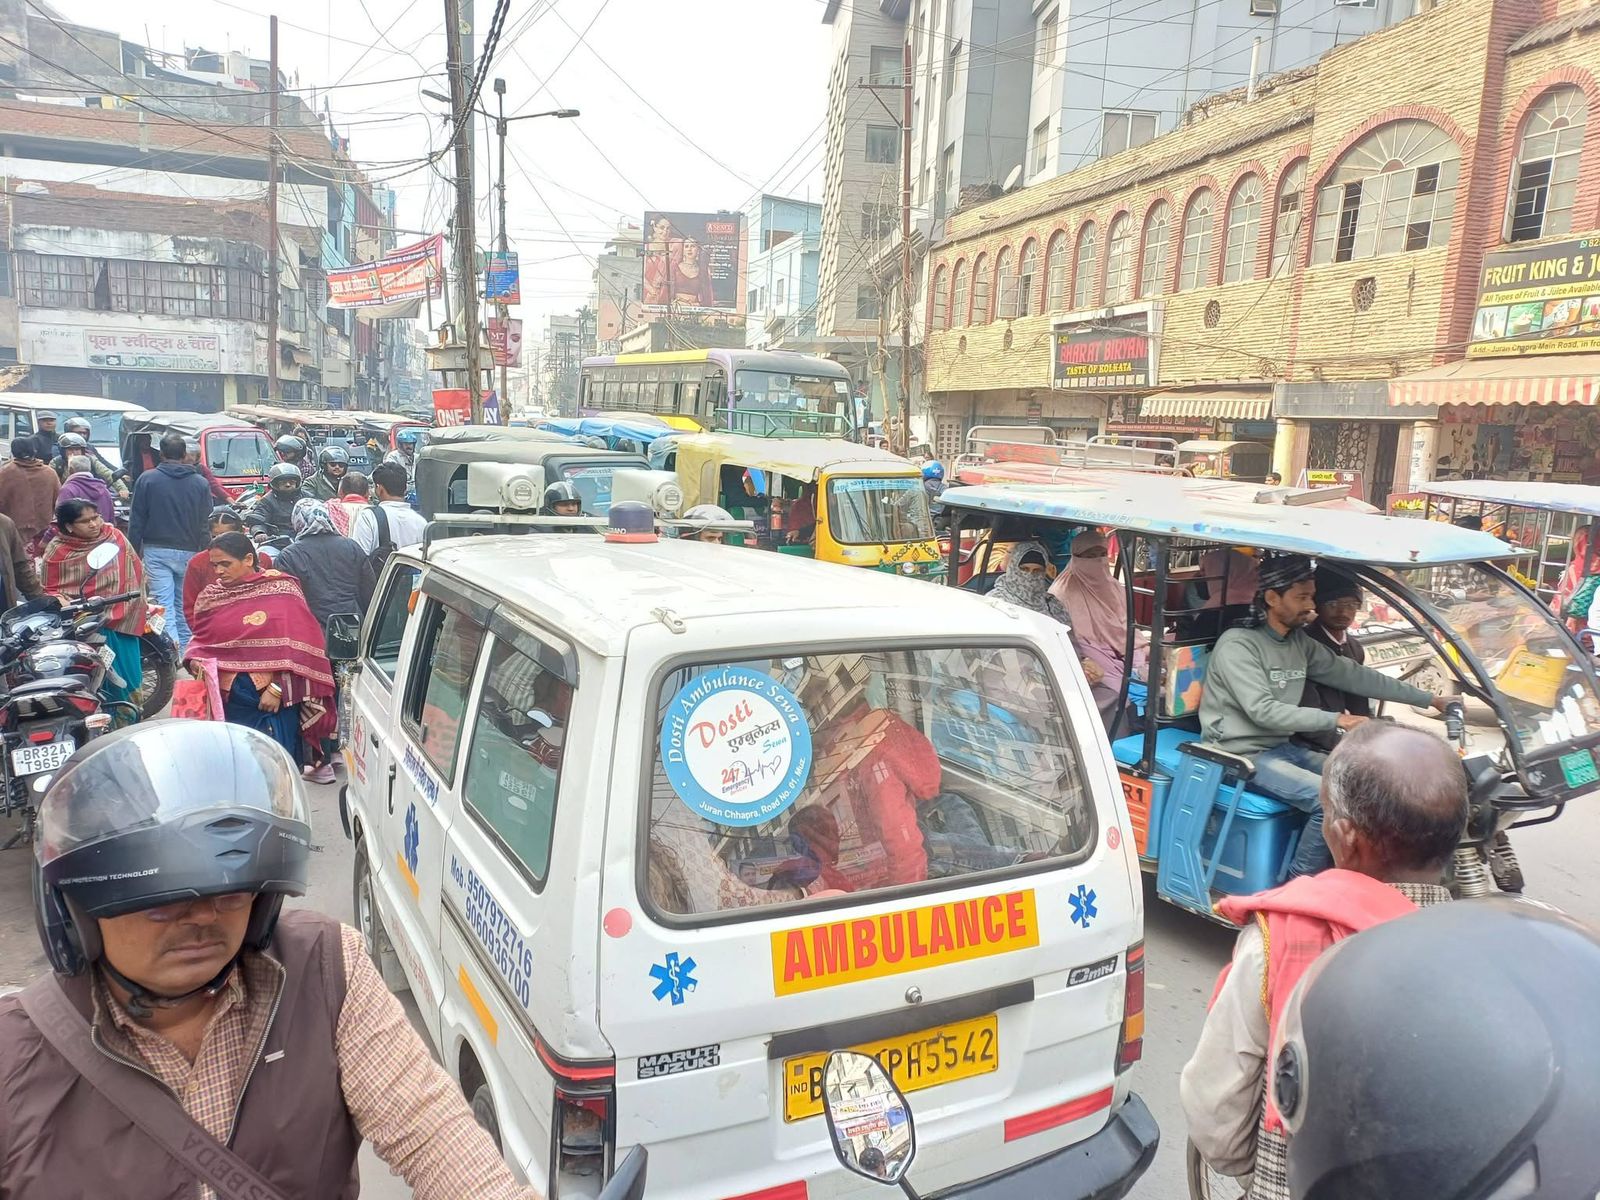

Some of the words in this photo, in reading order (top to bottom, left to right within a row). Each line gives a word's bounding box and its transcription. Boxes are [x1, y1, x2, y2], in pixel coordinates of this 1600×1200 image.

[1483, 264, 1527, 288] FRUIT
[1529, 257, 1568, 280] KING
[1572, 255, 1585, 275] &
[1484, 292, 1493, 302] All
[1495, 291, 1513, 303] Types
[1515, 290, 1521, 299] of
[1523, 288, 1540, 299] Fruit
[1541, 287, 1546, 297] &
[1548, 286, 1567, 297] Juice
[88, 335, 116, 350] पूजा
[177, 338, 188, 349] &
[188, 338, 216, 350] चाट
[1061, 341, 1102, 362] BHARAT
[1539, 342, 1556, 350] Main
[1066, 365, 1087, 375] TASTE
[1088, 364, 1098, 373] OF
[1099, 362, 1132, 373] KOLKATA
[668, 715, 685, 764] Dosti
[681, 667, 764, 714] Ambulance
[766, 686, 800, 723] Sewa
[688, 699, 753, 748] Dosti
[23, 743, 67, 761] BR32A
[699, 801, 723, 817] Juran
[761, 801, 780, 815] Road
[109, 867, 159, 880] TECHNOLOGY
[450, 854, 467, 889] Mob.
[467, 868, 533, 979] 9507972716
[783, 892, 1027, 982] AMBULANCE
[465, 896, 530, 1009] 9060936700
[1069, 959, 1116, 985] Omni
[640, 1045, 719, 1068] MARUTI
[640, 1055, 719, 1078] SUZUKI
[790, 1082, 808, 1095] IND
